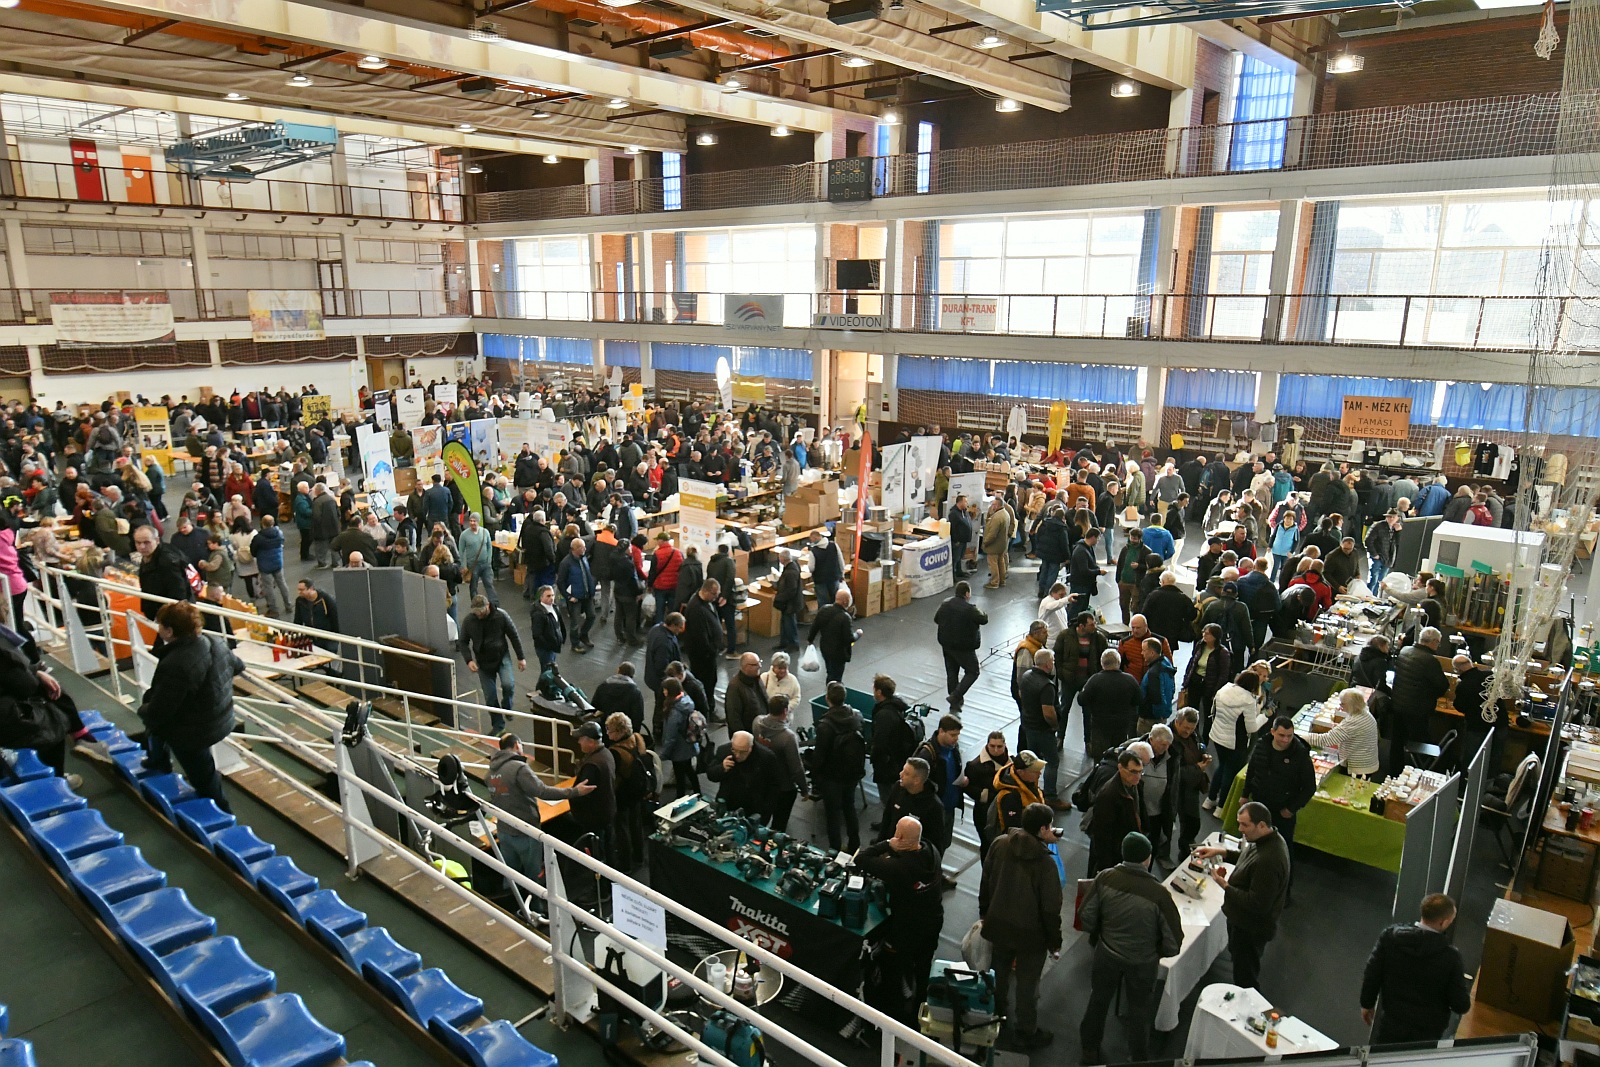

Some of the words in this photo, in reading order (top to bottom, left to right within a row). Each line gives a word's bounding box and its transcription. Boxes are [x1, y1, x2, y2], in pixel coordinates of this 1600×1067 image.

[942, 303, 997, 314] DURAN-TRANS
[829, 316, 882, 328] VIDEOTON
[1344, 400, 1363, 411] TAM
[1371, 399, 1391, 412] MÉZ
[1393, 402, 1411, 413] Kft.
[1358, 417, 1393, 427] TAMÁSI
[1344, 425, 1405, 437] MÉHÉSZBOLT
[733, 918, 787, 954] XGT
